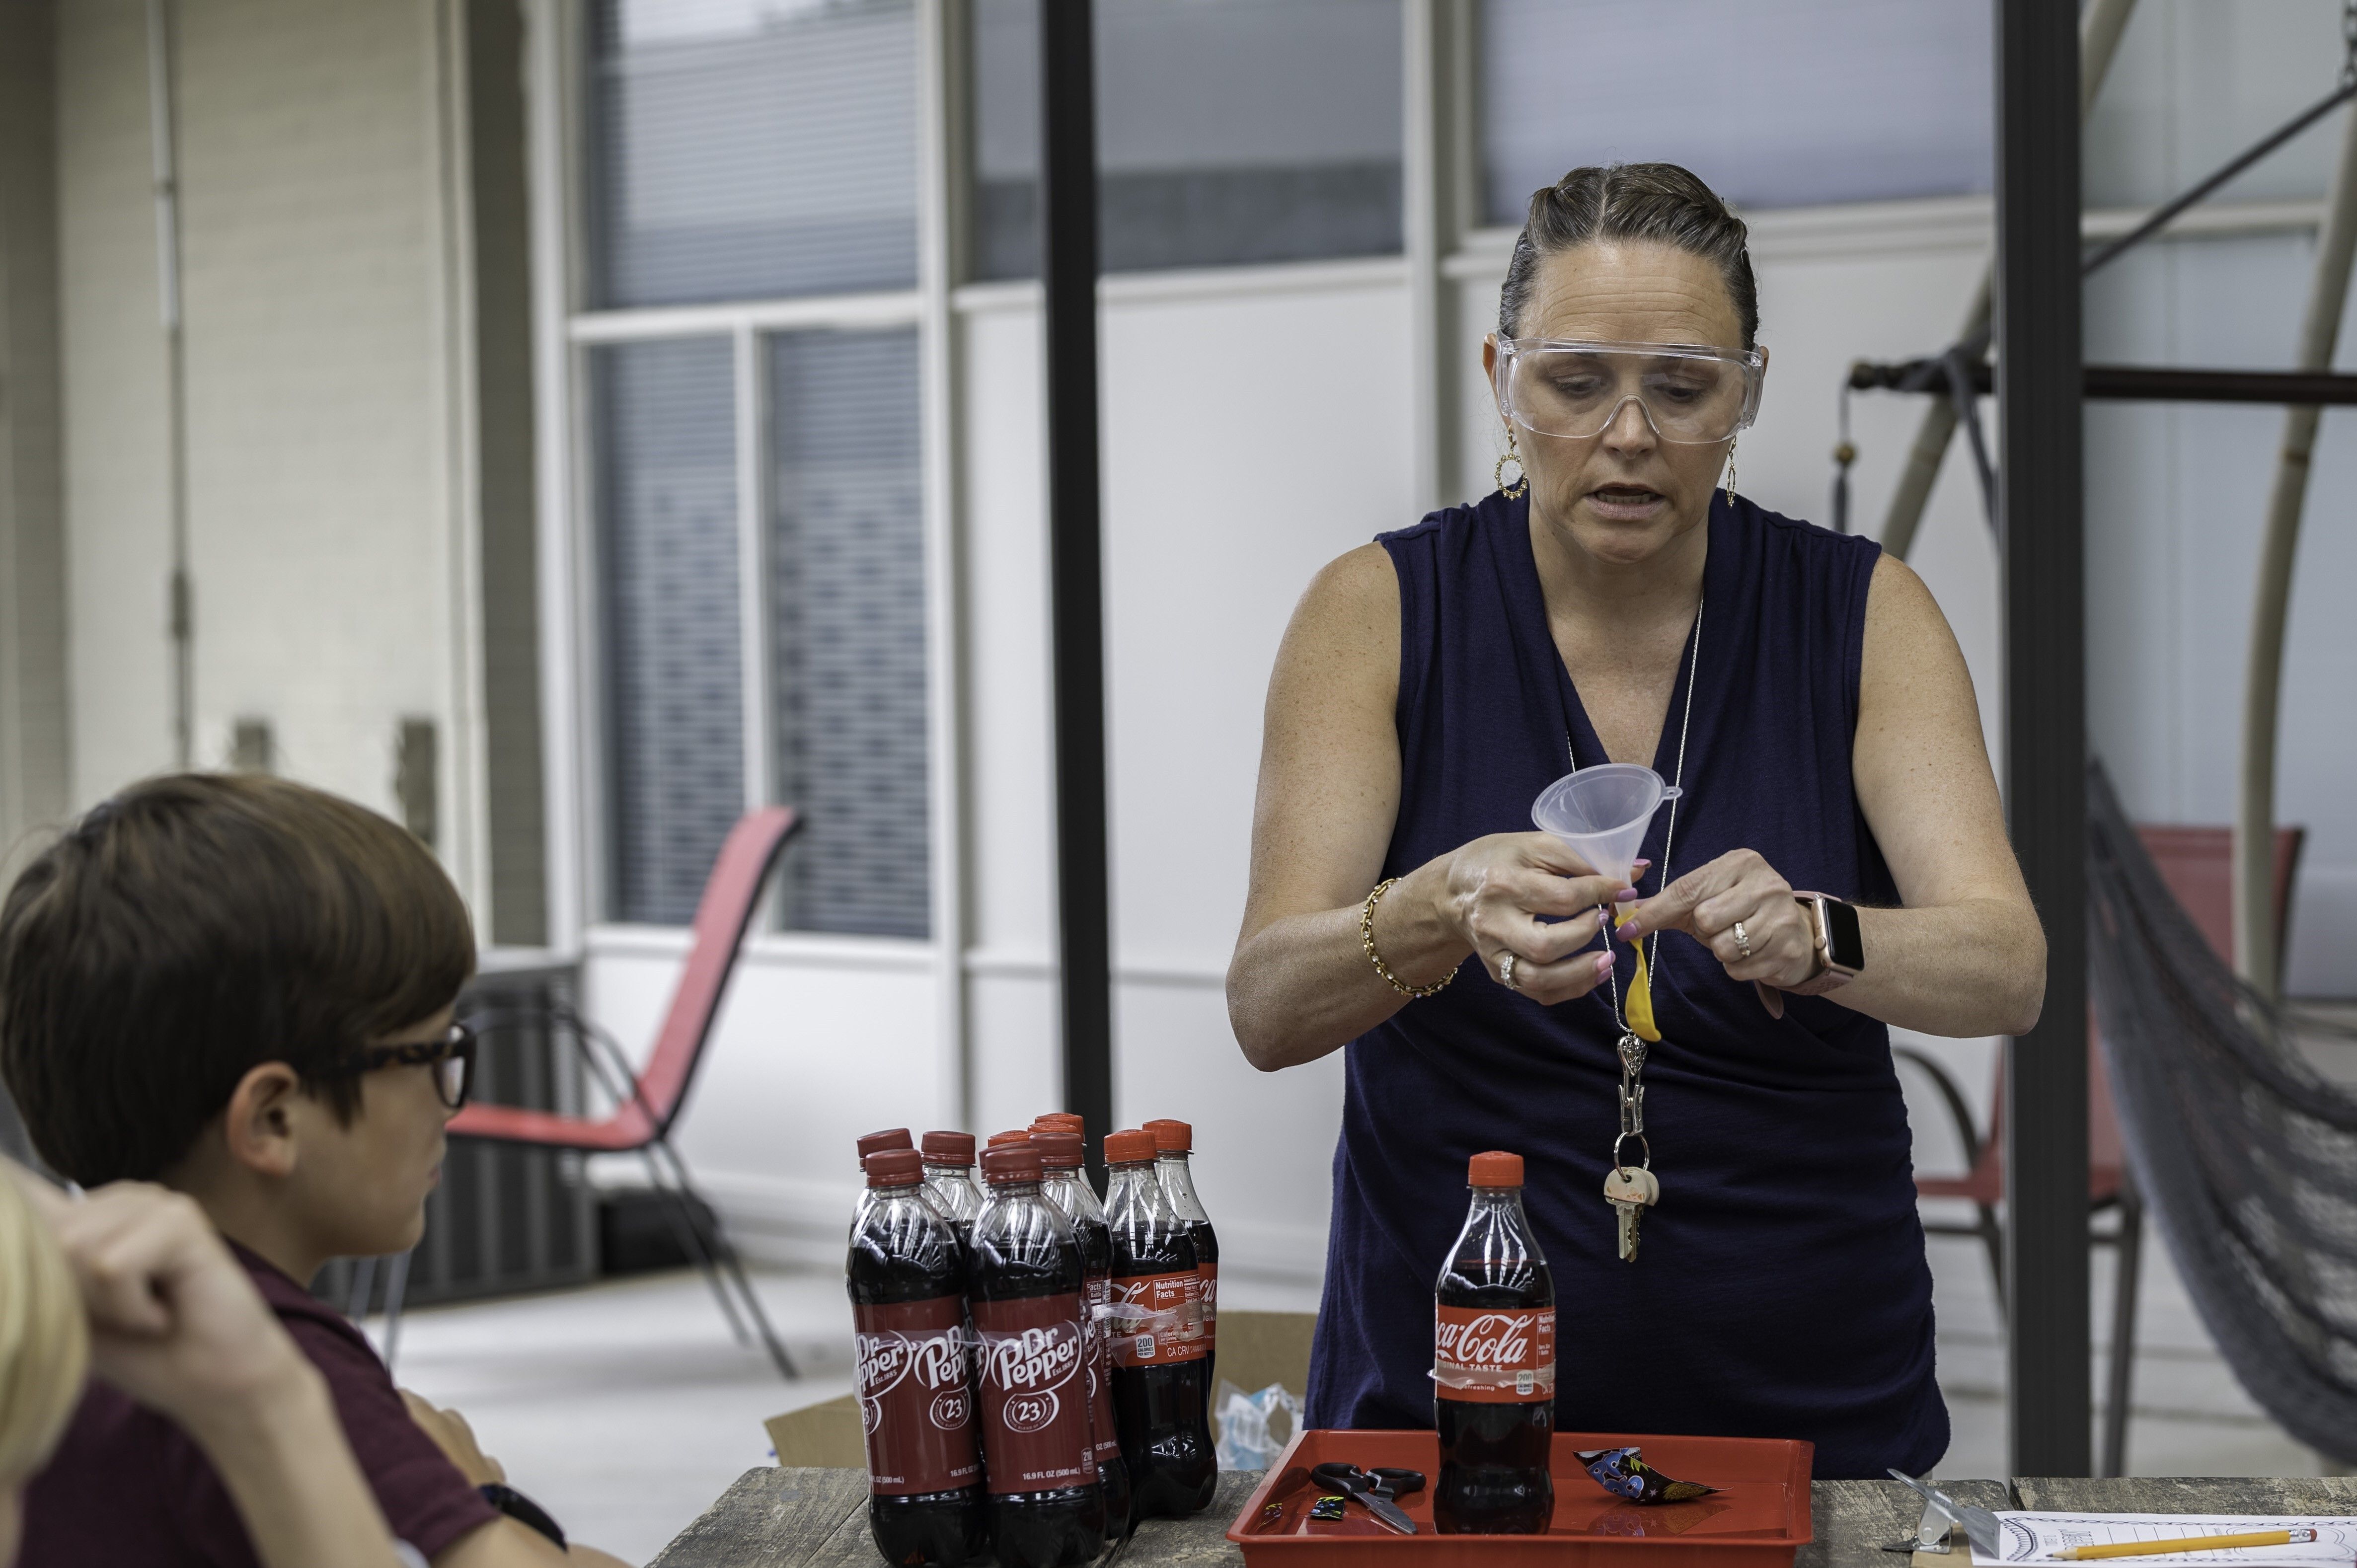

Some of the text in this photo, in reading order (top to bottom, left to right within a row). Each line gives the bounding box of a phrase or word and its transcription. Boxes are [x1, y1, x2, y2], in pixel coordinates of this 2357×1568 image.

[1155, 1280, 1183, 1290] Nutrition
[1021, 1328, 1059, 1361] Dr
[1138, 1338, 1153, 1347] 200
[1438, 1315, 1535, 1363] ca-Cola
[857, 1335, 880, 1364] Dr
[1167, 1346, 1177, 1357] CA
[1178, 1345, 1189, 1356] CRV
[860, 1345, 904, 1392] pper
[920, 1337, 968, 1390] Pepp
[997, 1335, 1077, 1391] Pepper
[1469, 1364, 1503, 1372] TASTE
[945, 1399, 963, 1419] 23
[1018, 1402, 1041, 1421] 23
[1046, 1470, 1055, 1478] OZ
[1056, 1469, 1070, 1478] (500
